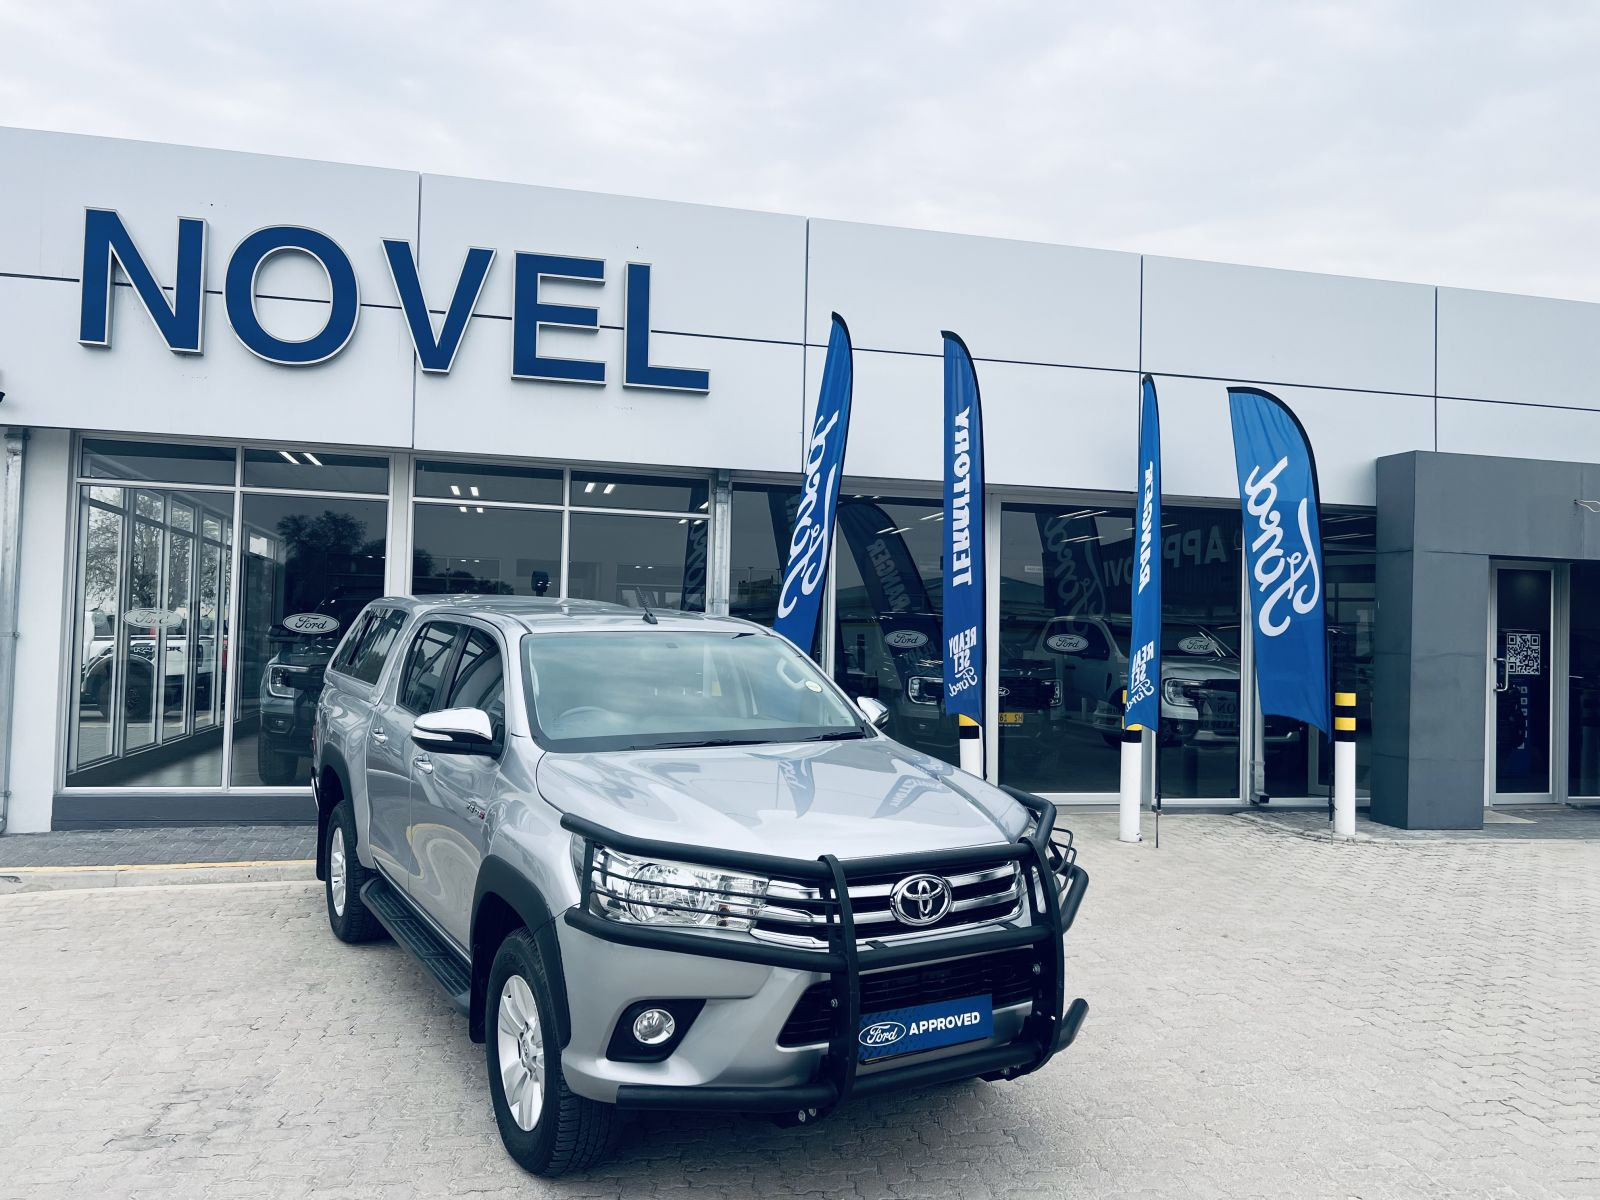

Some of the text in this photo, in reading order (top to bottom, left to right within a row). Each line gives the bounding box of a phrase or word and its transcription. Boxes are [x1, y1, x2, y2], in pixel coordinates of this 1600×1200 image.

[79, 206, 710, 394] NOVEL
[866, 1011, 981, 1044] Ford APPROVED
